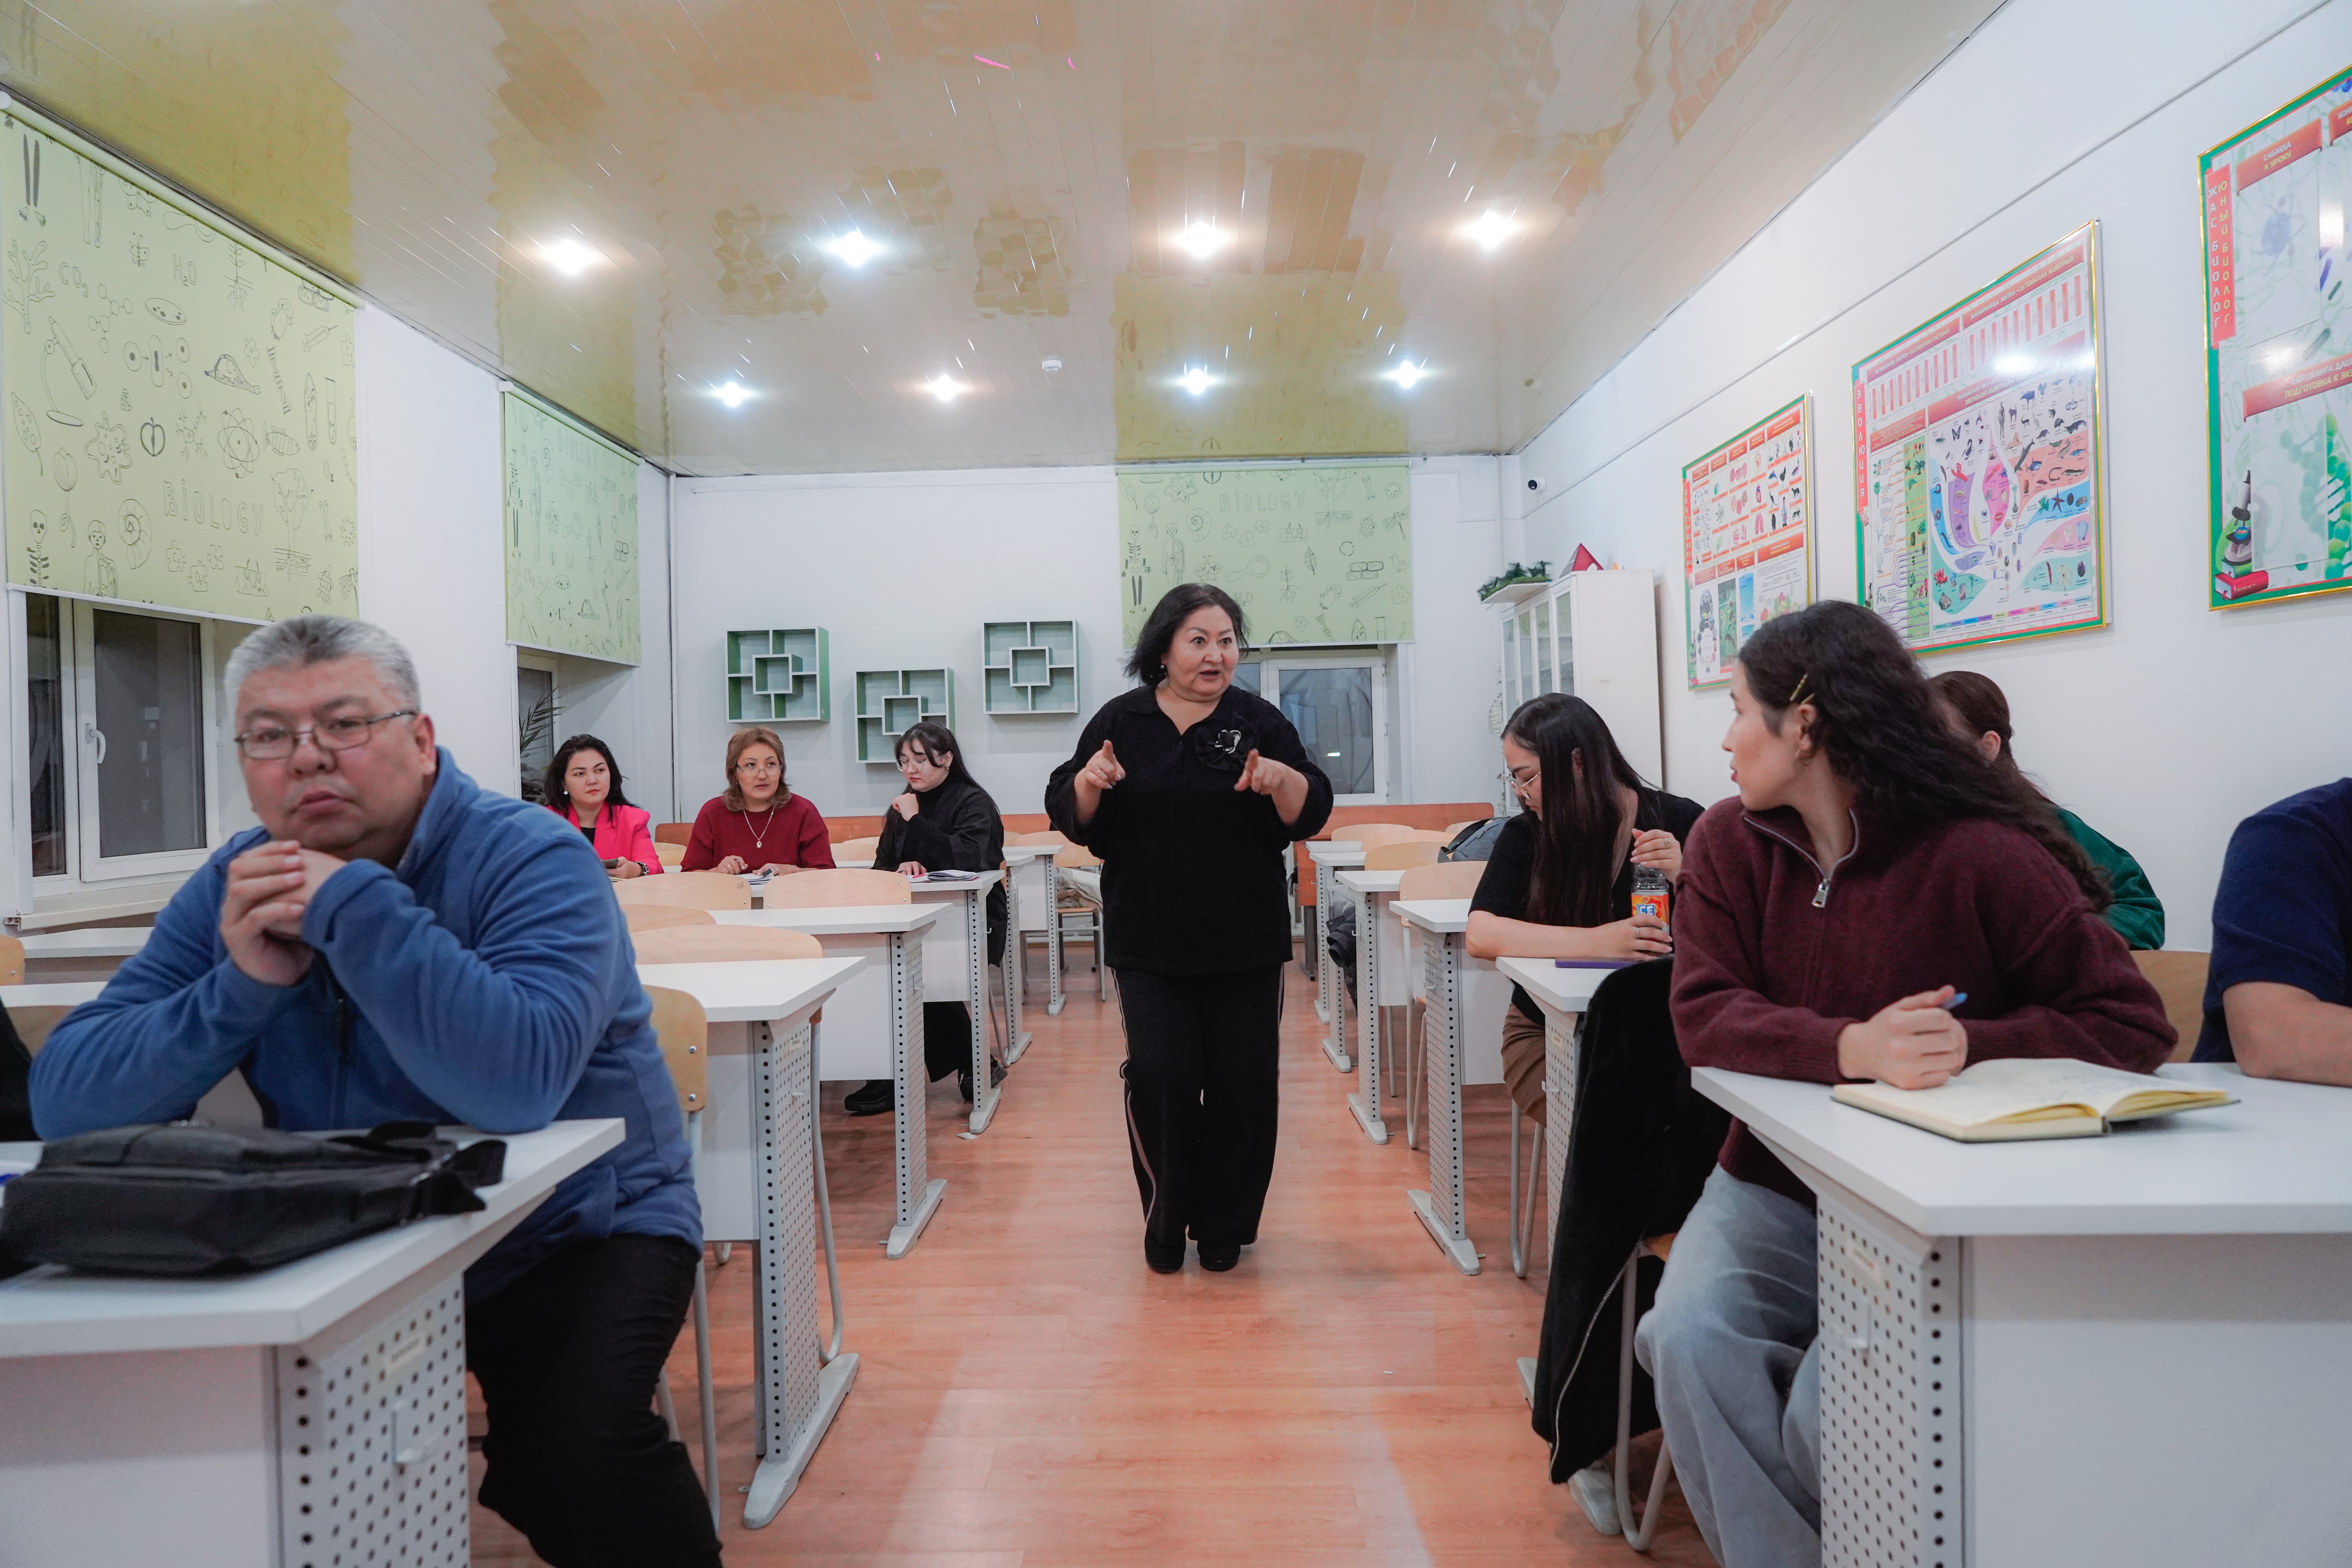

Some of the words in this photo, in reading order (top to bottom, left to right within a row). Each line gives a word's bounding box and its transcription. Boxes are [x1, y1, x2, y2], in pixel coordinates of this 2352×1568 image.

[2208, 185, 2218, 228] ЖАС
[2218, 180, 2228, 235] ЮНЫЙ
[2211, 240, 2221, 328] БИОЛОГ
[2221, 242, 2230, 324] БИОЛОГ
[2285, 376, 2332, 398] ПОДГОТОВКА
[2333, 374, 2339, 382] К
[1857, 389, 1865, 498] ЭВОЛЮЦИЯ
[1635, 903, 1656, 915] ICE
